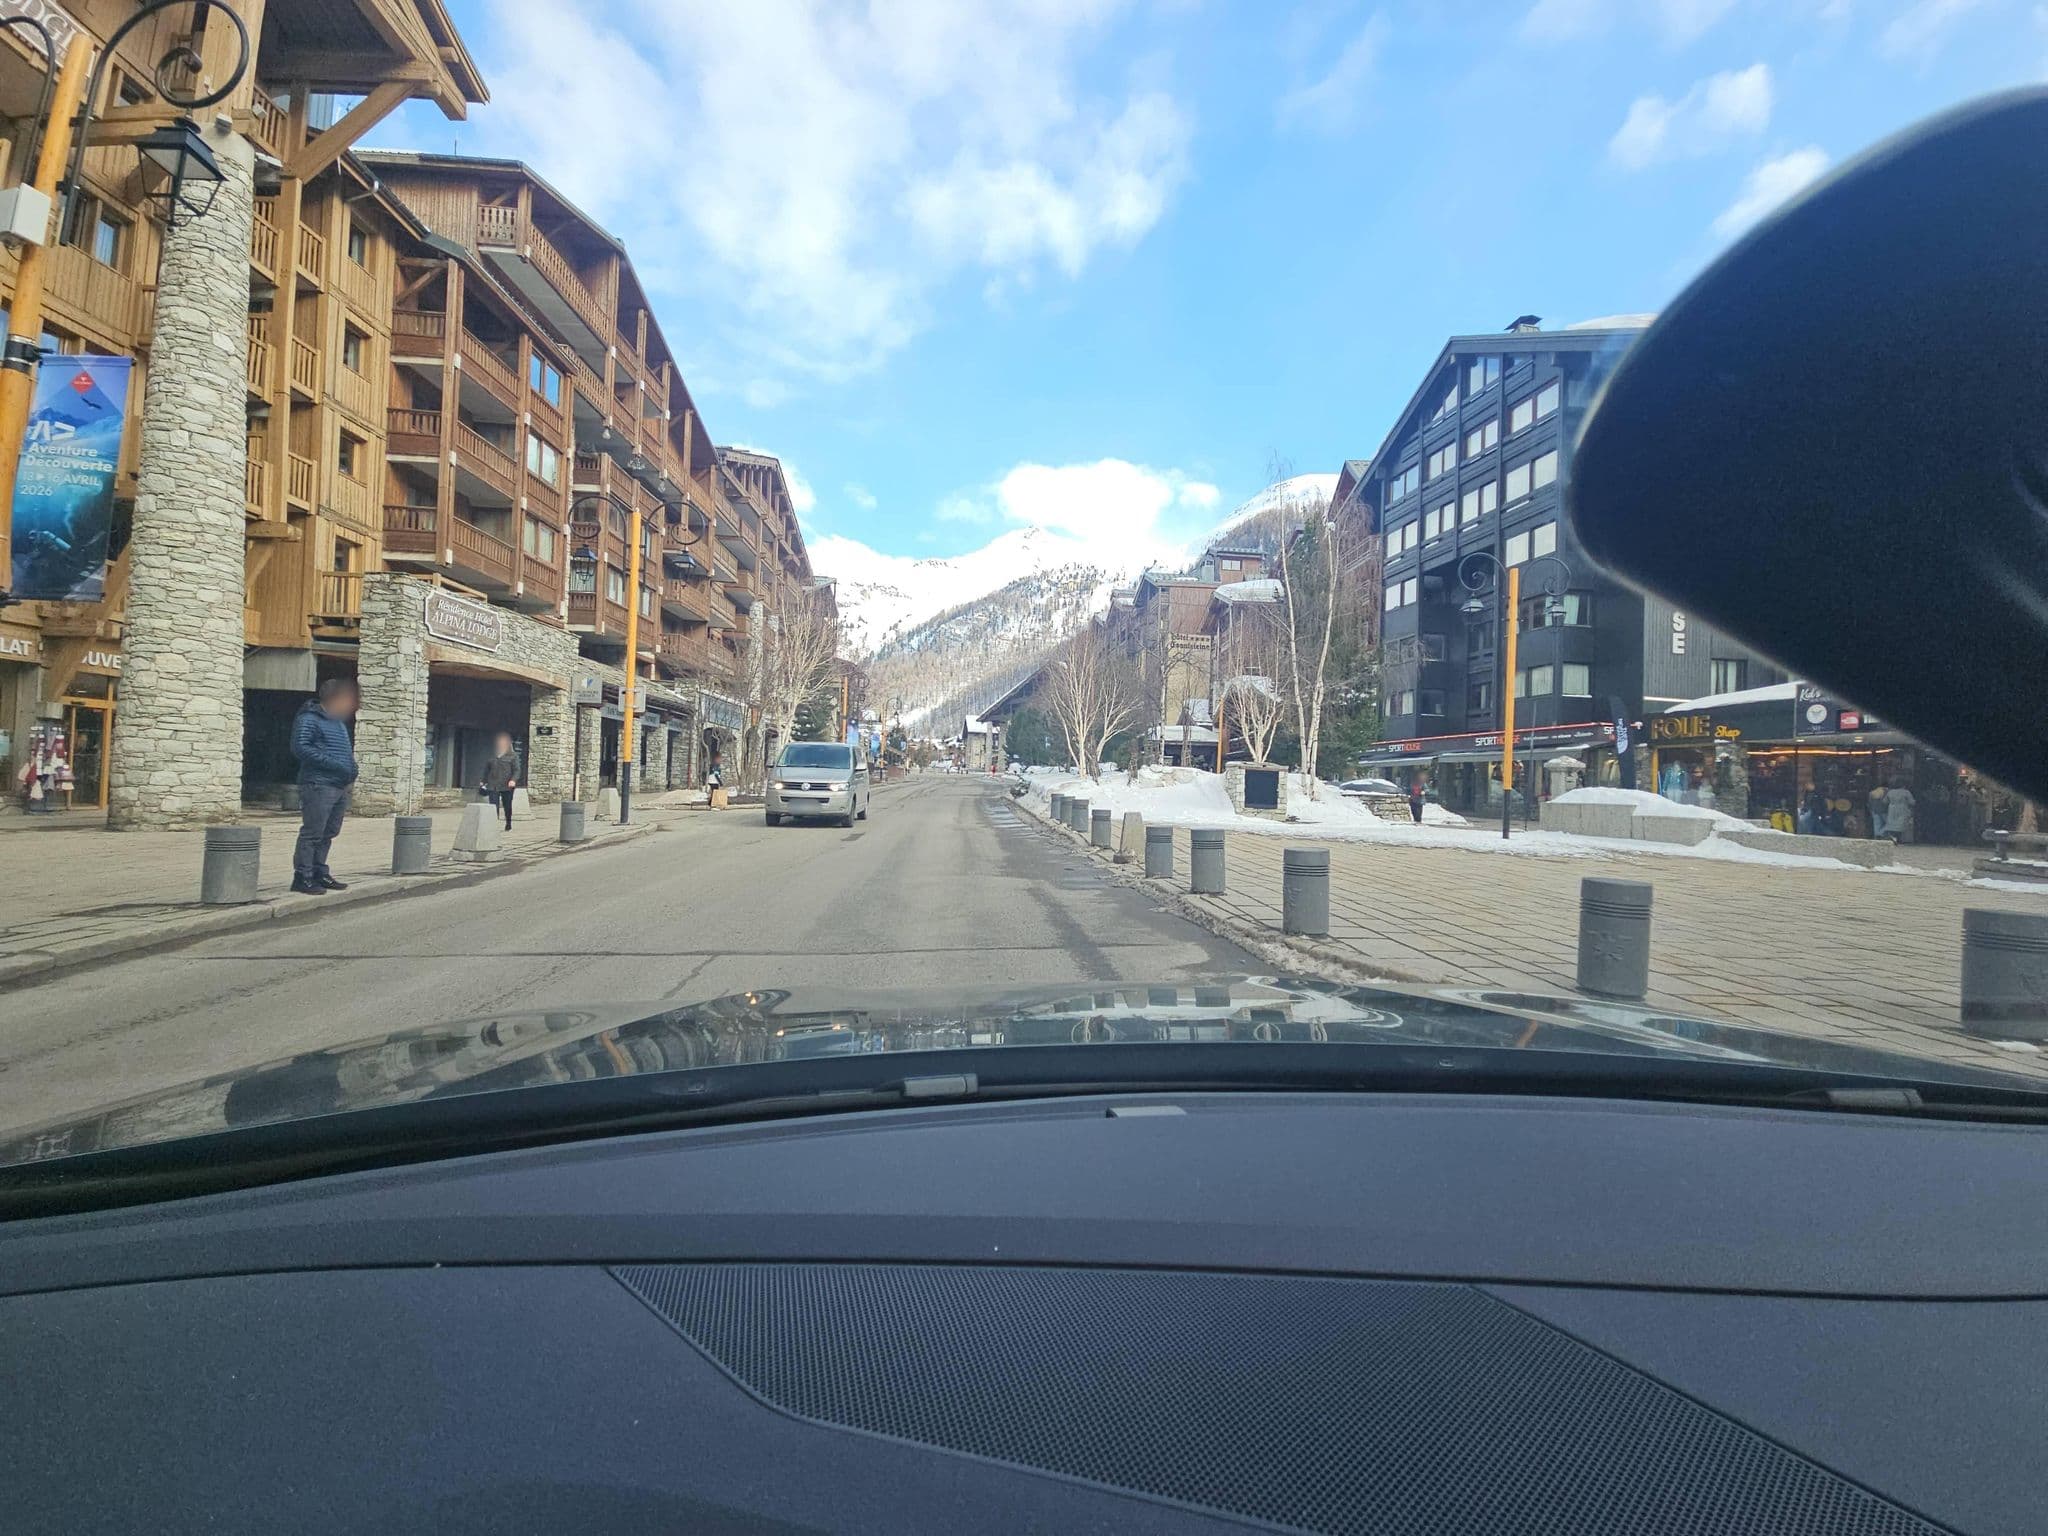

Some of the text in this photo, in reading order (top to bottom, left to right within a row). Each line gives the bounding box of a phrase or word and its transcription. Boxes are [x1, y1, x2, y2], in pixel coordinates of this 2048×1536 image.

[28, 442, 98, 457] Aventure
[25, 454, 113, 472] Découverte
[63, 473, 100, 486] AVRIL
[20, 484, 53, 496] 2026
[432, 611, 498, 640] ALPINA LODGE
[1651, 715, 1711, 739] FOLIE
